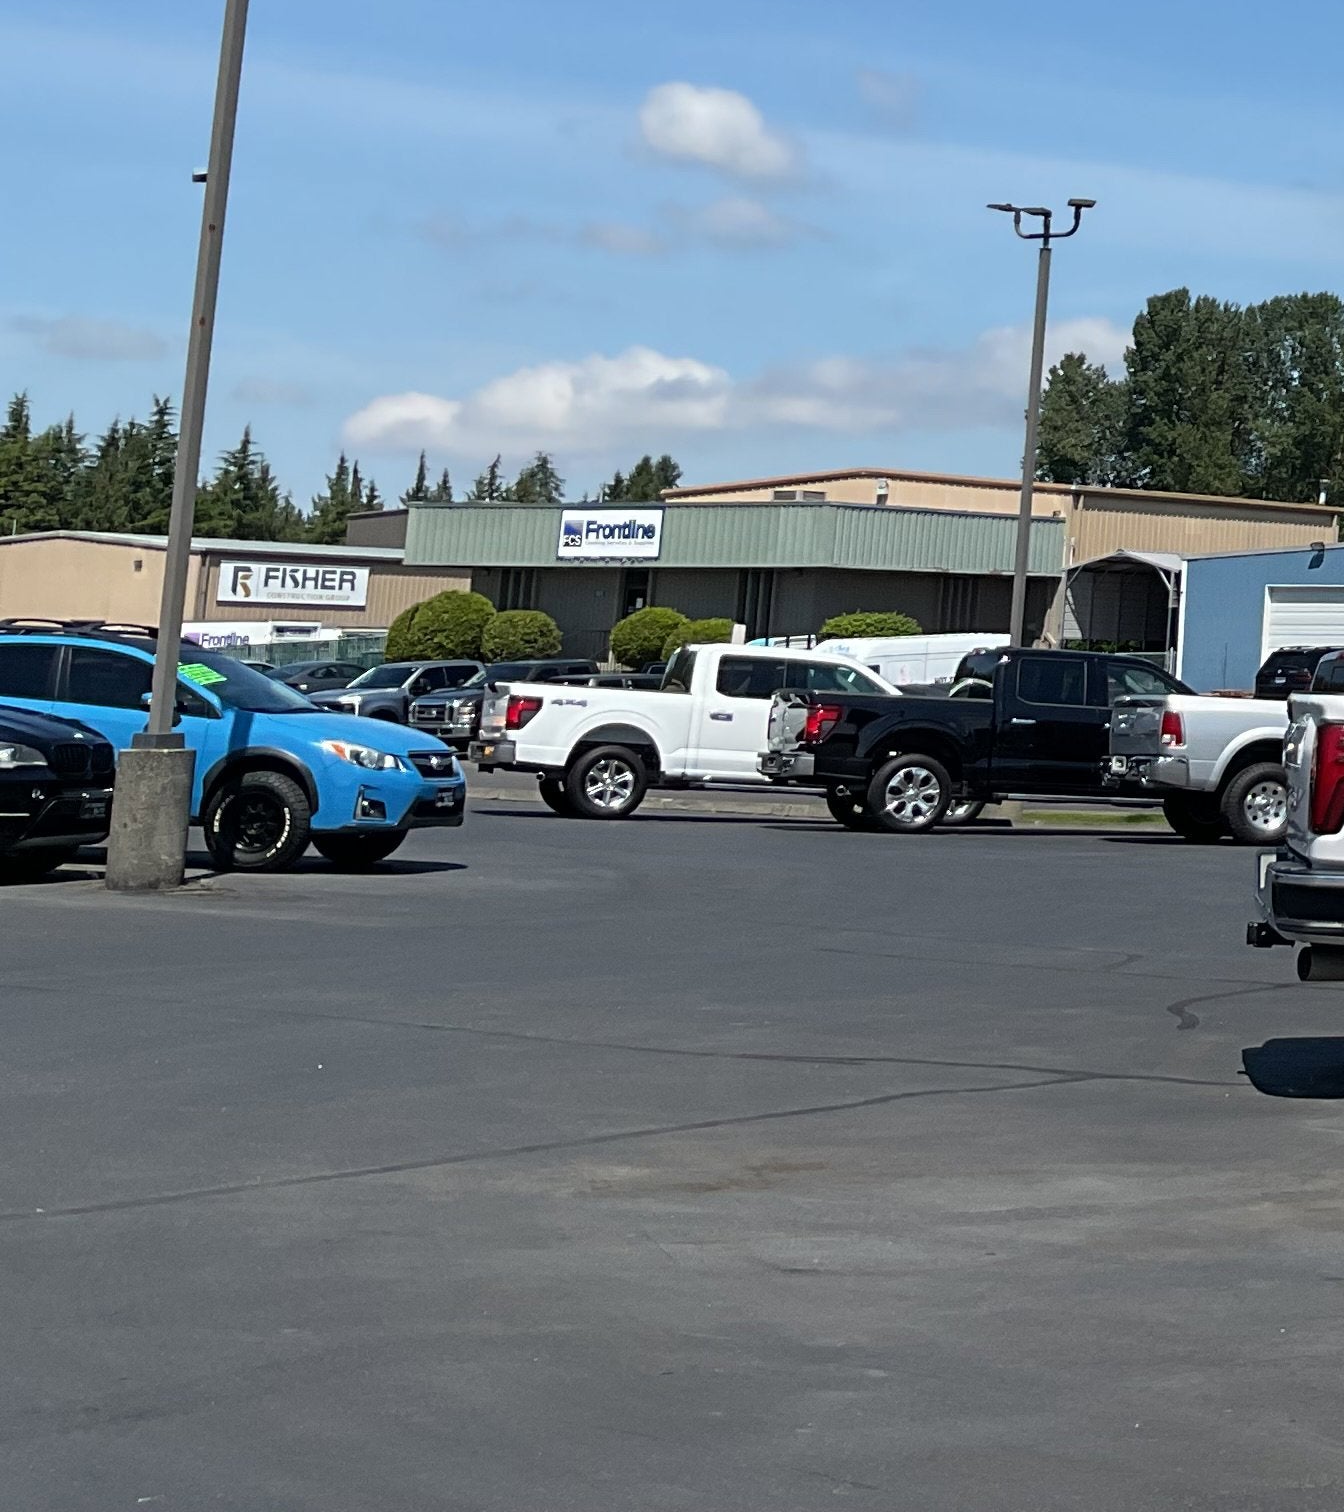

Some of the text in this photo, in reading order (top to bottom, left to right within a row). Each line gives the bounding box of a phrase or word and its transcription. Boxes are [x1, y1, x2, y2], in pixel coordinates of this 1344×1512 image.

[585, 519, 656, 539] Frontline
[263, 567, 357, 591] FISHER
[202, 632, 249, 646] Frontline
